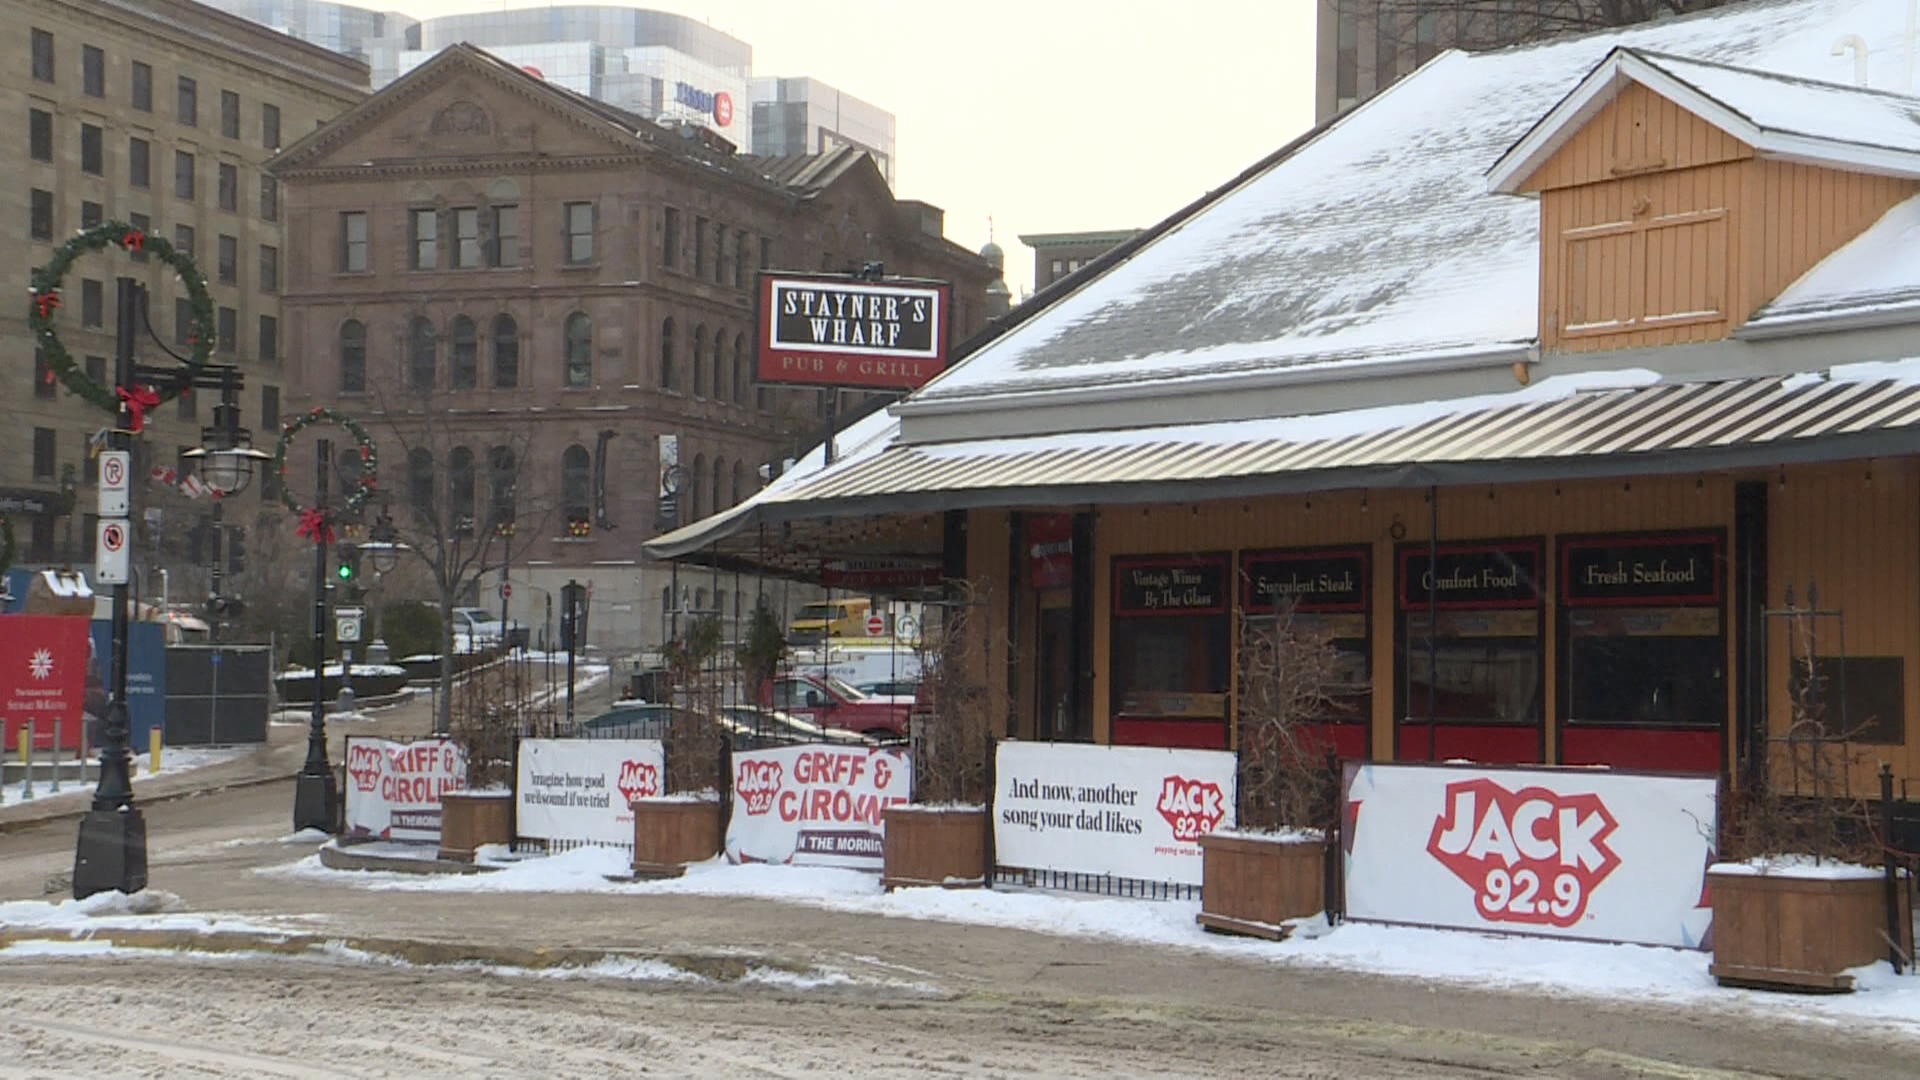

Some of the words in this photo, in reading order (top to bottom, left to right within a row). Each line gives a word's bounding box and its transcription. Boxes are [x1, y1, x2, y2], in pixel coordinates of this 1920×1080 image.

[784, 290, 926, 323] STAYNER'S
[810, 317, 901, 347] WHARF
[782, 356, 824, 371] PUB
[836, 359, 849, 372] &
[859, 361, 923, 378] GRILL
[1171, 568, 1202, 585] Wines
[1319, 571, 1353, 593] Steak
[1482, 565, 1517, 588] Food
[1586, 563, 1628, 585] Fresh
[1633, 558, 1695, 584] Seafood
[1144, 590, 1158, 609] By
[1162, 587, 1181, 606] The
[1183, 587, 1212, 606] Glass
[584, 773, 605, 789] good
[620, 765, 656, 793] JACK
[739, 765, 781, 795] JACK
[874, 758, 892, 790] &
[577, 798, 589, 807] we
[590, 792, 610, 808] tried
[748, 794, 772, 811] 92.9
[1009, 777, 1039, 800] And
[1042, 786, 1076, 804] now,
[1077, 783, 1138, 806] another
[1161, 780, 1220, 818] JACK
[1002, 808, 1038, 831] song
[1039, 811, 1074, 832] your
[1076, 808, 1102, 831] dad
[1105, 810, 1142, 834] likes
[1437, 790, 1607, 874] JACK
[809, 836, 834, 851] THE
[1482, 867, 1581, 918] 92.9
